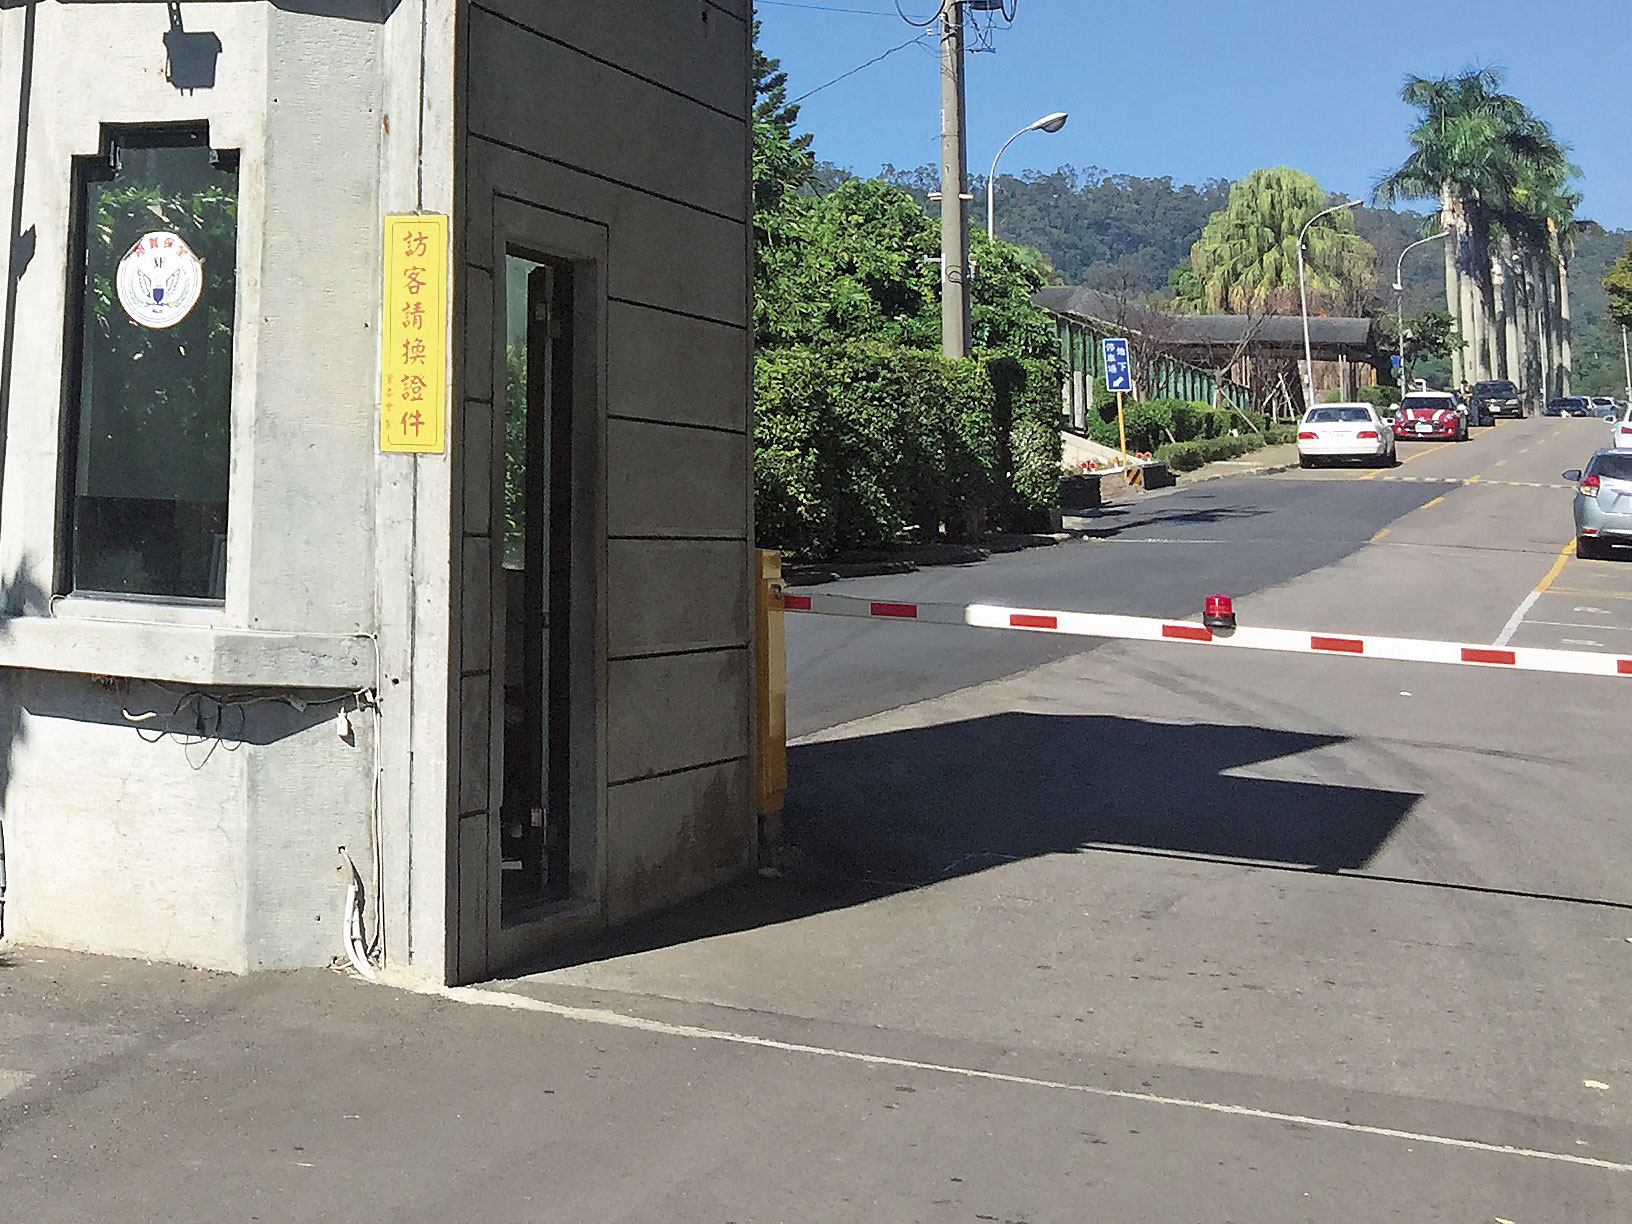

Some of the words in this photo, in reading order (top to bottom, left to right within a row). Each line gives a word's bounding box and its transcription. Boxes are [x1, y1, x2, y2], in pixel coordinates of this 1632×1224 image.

[400, 230, 429, 437] 訪客請換證件
